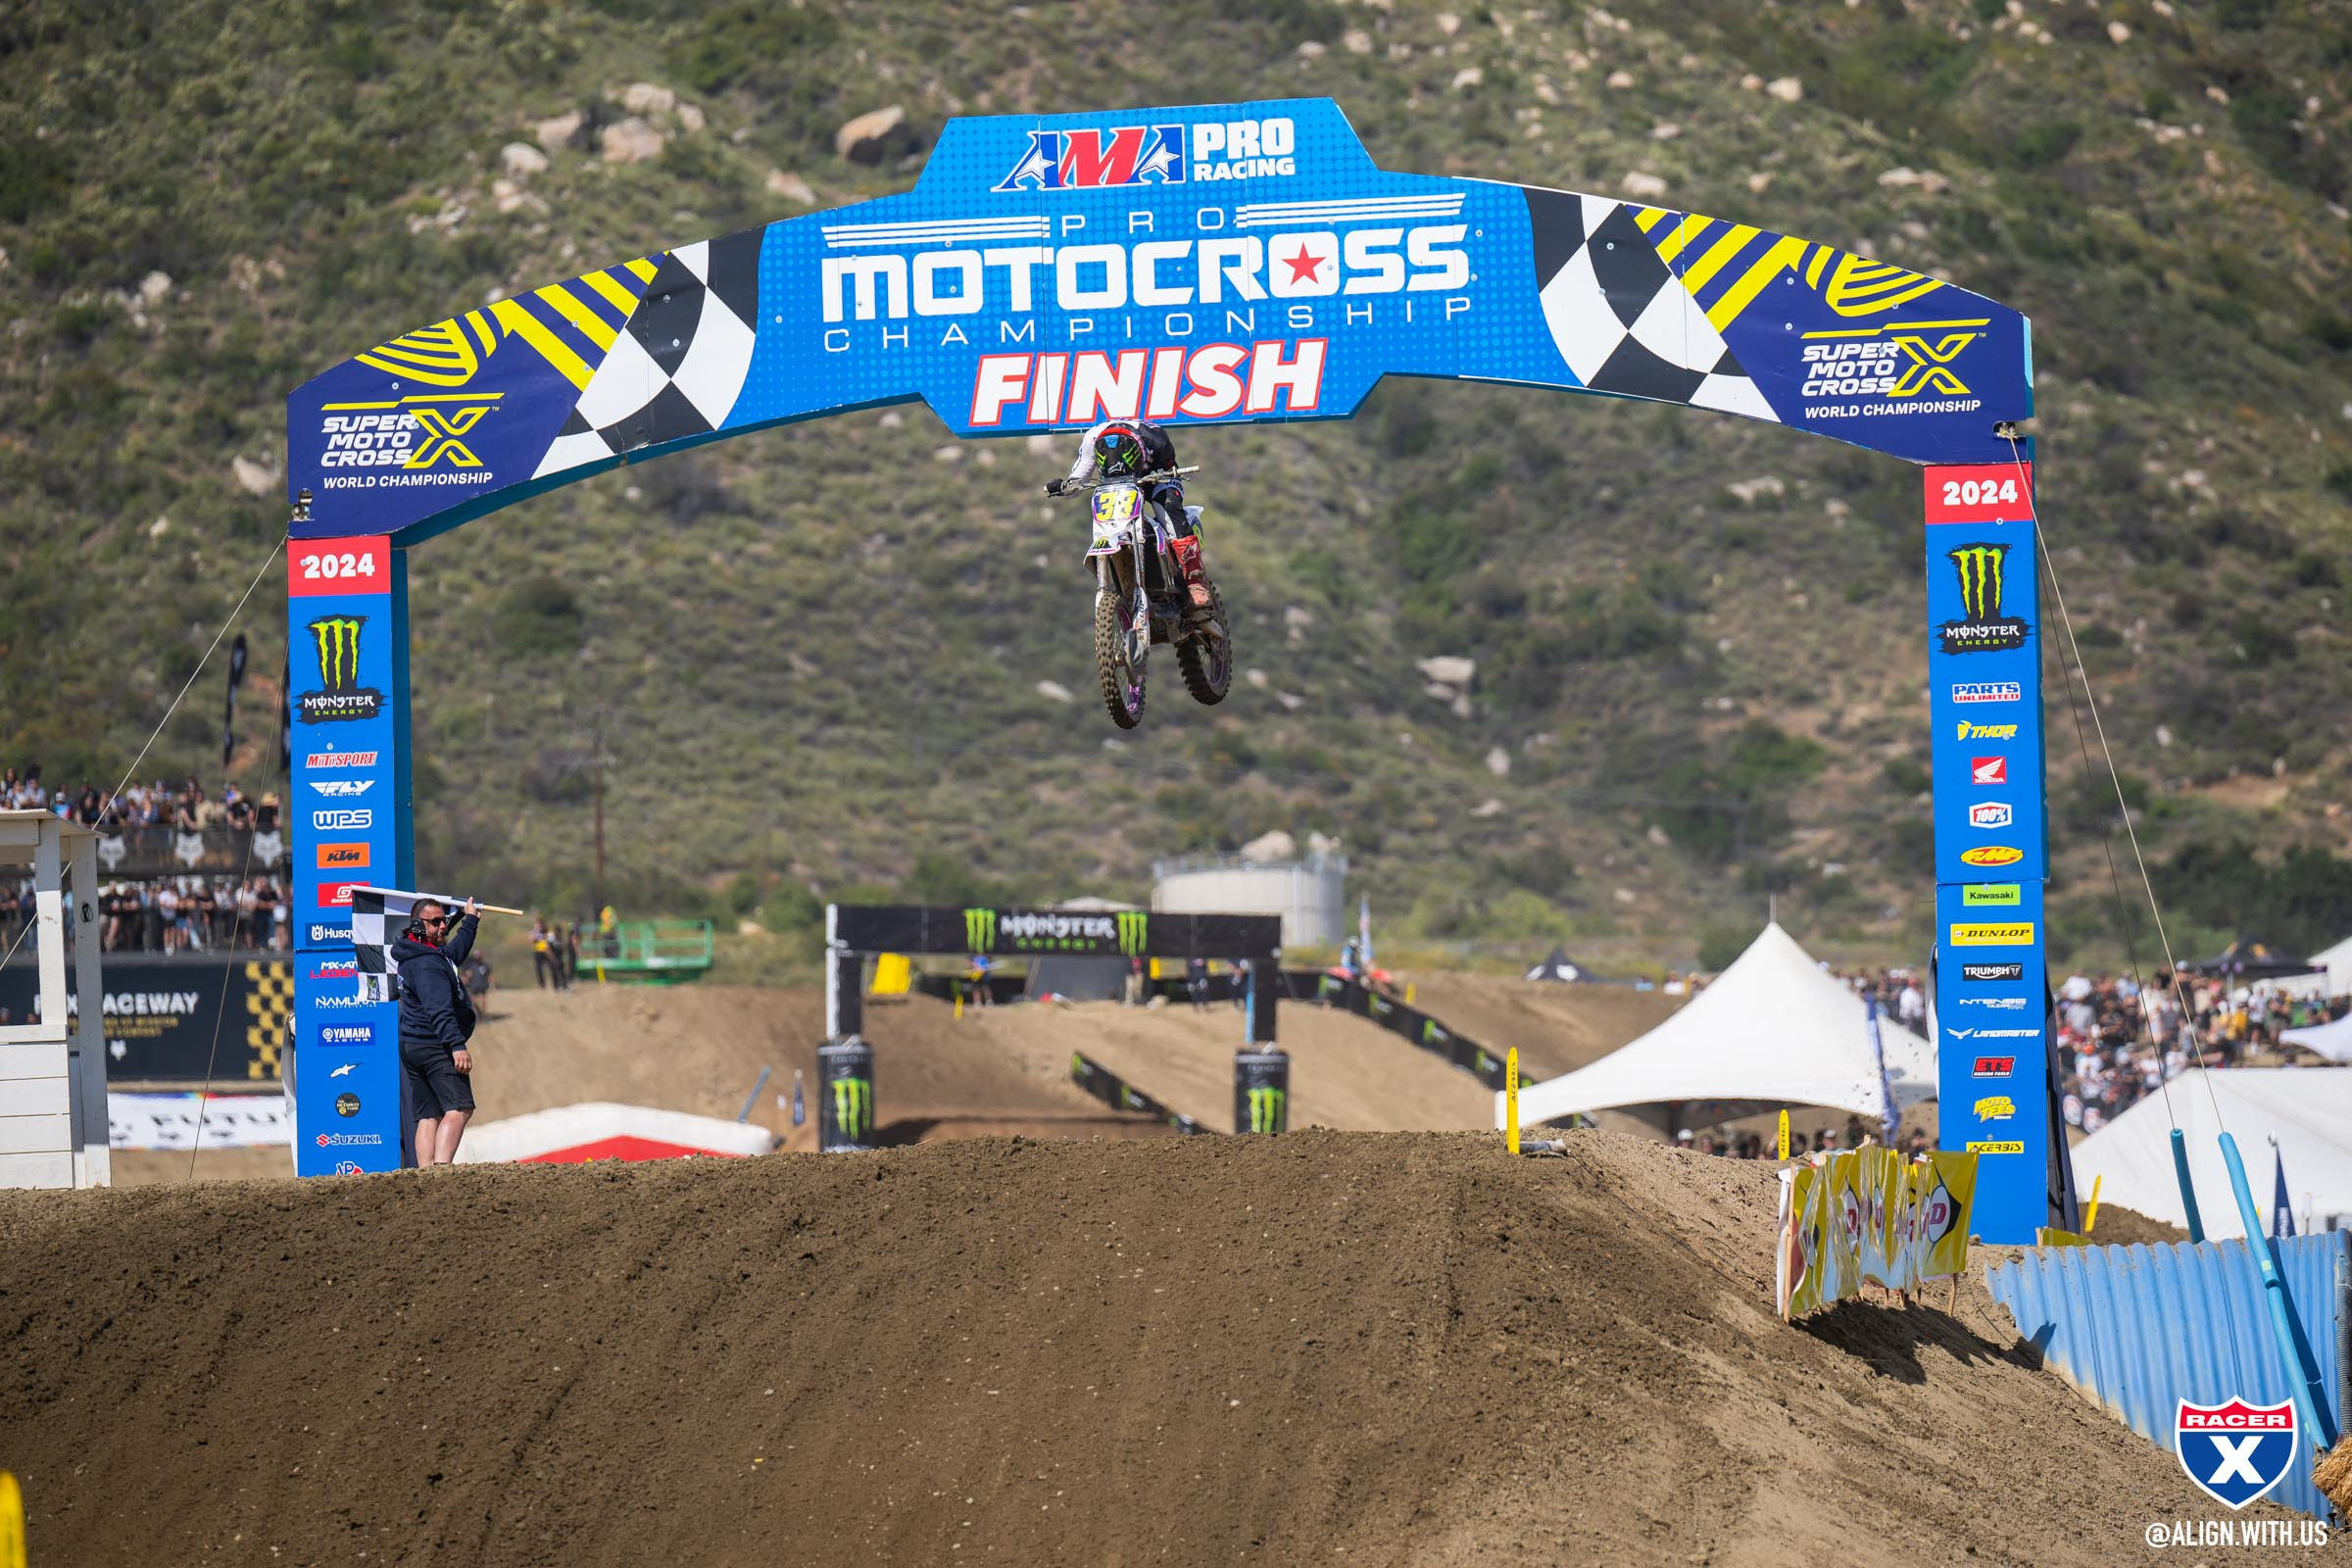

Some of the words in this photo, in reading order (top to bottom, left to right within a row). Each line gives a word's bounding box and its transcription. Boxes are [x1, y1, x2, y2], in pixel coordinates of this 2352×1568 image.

[1193, 118, 1295, 161] PRO
[990, 123, 1185, 192] AMA
[1194, 157, 1296, 181] RACING
[1062, 208, 1225, 237] PRO
[821, 223, 1472, 322] MOTOCROSS
[824, 298, 1472, 353] CHAMPIONSHIP
[1801, 342, 1899, 362] SUPER
[1808, 360, 1895, 378] MOTO
[969, 337, 1329, 426] FINISH
[1801, 377, 1897, 397] CROSS
[1805, 406, 1859, 418] WORLD
[1866, 400, 1981, 416] CHAMPIONSHIP
[321, 415, 416, 433] SUPER
[327, 432, 411, 450] MOTO
[320, 449, 413, 467] CROSS
[323, 476, 375, 489] WORLD
[379, 472, 493, 487] CHAMPIONSHIP
[1942, 480, 2018, 505] 2024
[304, 554, 374, 578] 2024
[1946, 624, 2020, 639] MONSTER
[1957, 638, 2008, 647] ENERGY
[1954, 684, 2019, 694] PARTS
[1954, 693, 2019, 702] UNLIMITED
[305, 694, 374, 710] MONSTER
[1971, 724, 2018, 738] THOR
[309, 780, 375, 793] FLY
[315, 810, 370, 828] WPS
[1975, 808, 2006, 823] 100%
[326, 850, 360, 861] KTM
[324, 928, 353, 941] Husqv
[310, 968, 359, 979] LEGEN
[1964, 966, 2009, 978] TRIUMPH
[333, 1027, 371, 1039] YAMAHA
[1973, 1029, 2039, 1038] LANDMASTER
[1975, 1057, 2014, 1072] ETS
[1973, 1097, 2012, 1115] MOTO
[1980, 1104, 2016, 1122] TEES
[330, 1134, 380, 1145] SUZUKI
